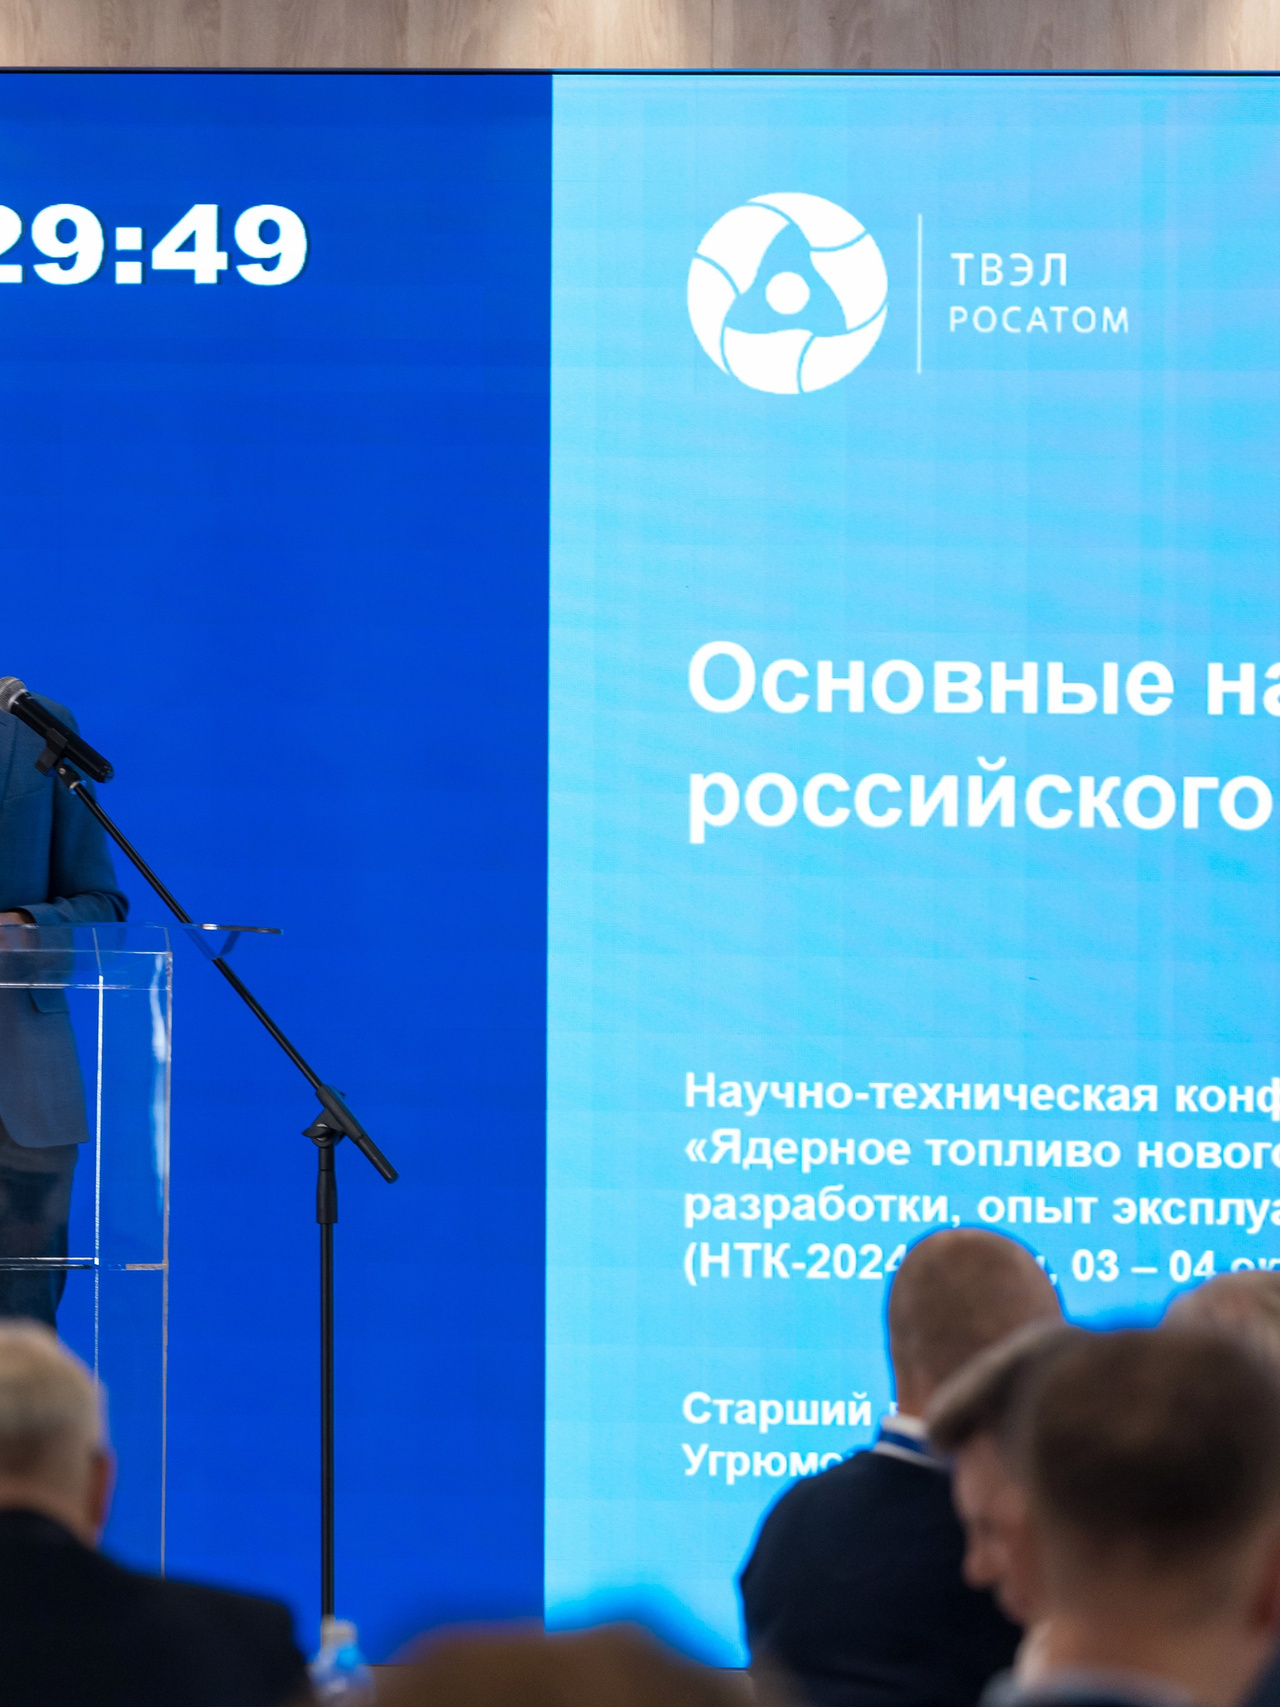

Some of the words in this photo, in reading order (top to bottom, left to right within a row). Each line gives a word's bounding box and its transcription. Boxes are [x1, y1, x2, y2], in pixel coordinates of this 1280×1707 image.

[950, 252, 1067, 287] ТВЭЛ
[949, 305, 1129, 333] РОСАТОМ
[688, 640, 1175, 716] Основные
[688, 756, 1273, 845] российского
[685, 1071, 1159, 1117] Научно-техническая
[684, 1128, 911, 1174] «Ядерное
[924, 1138, 1121, 1168] топливо
[684, 1184, 961, 1230] разработки,
[977, 1195, 1099, 1224] опыт
[1071, 1248, 1119, 1282] 03
[1169, 1249, 1216, 1283] 04
[682, 1390, 872, 1434] Старший
